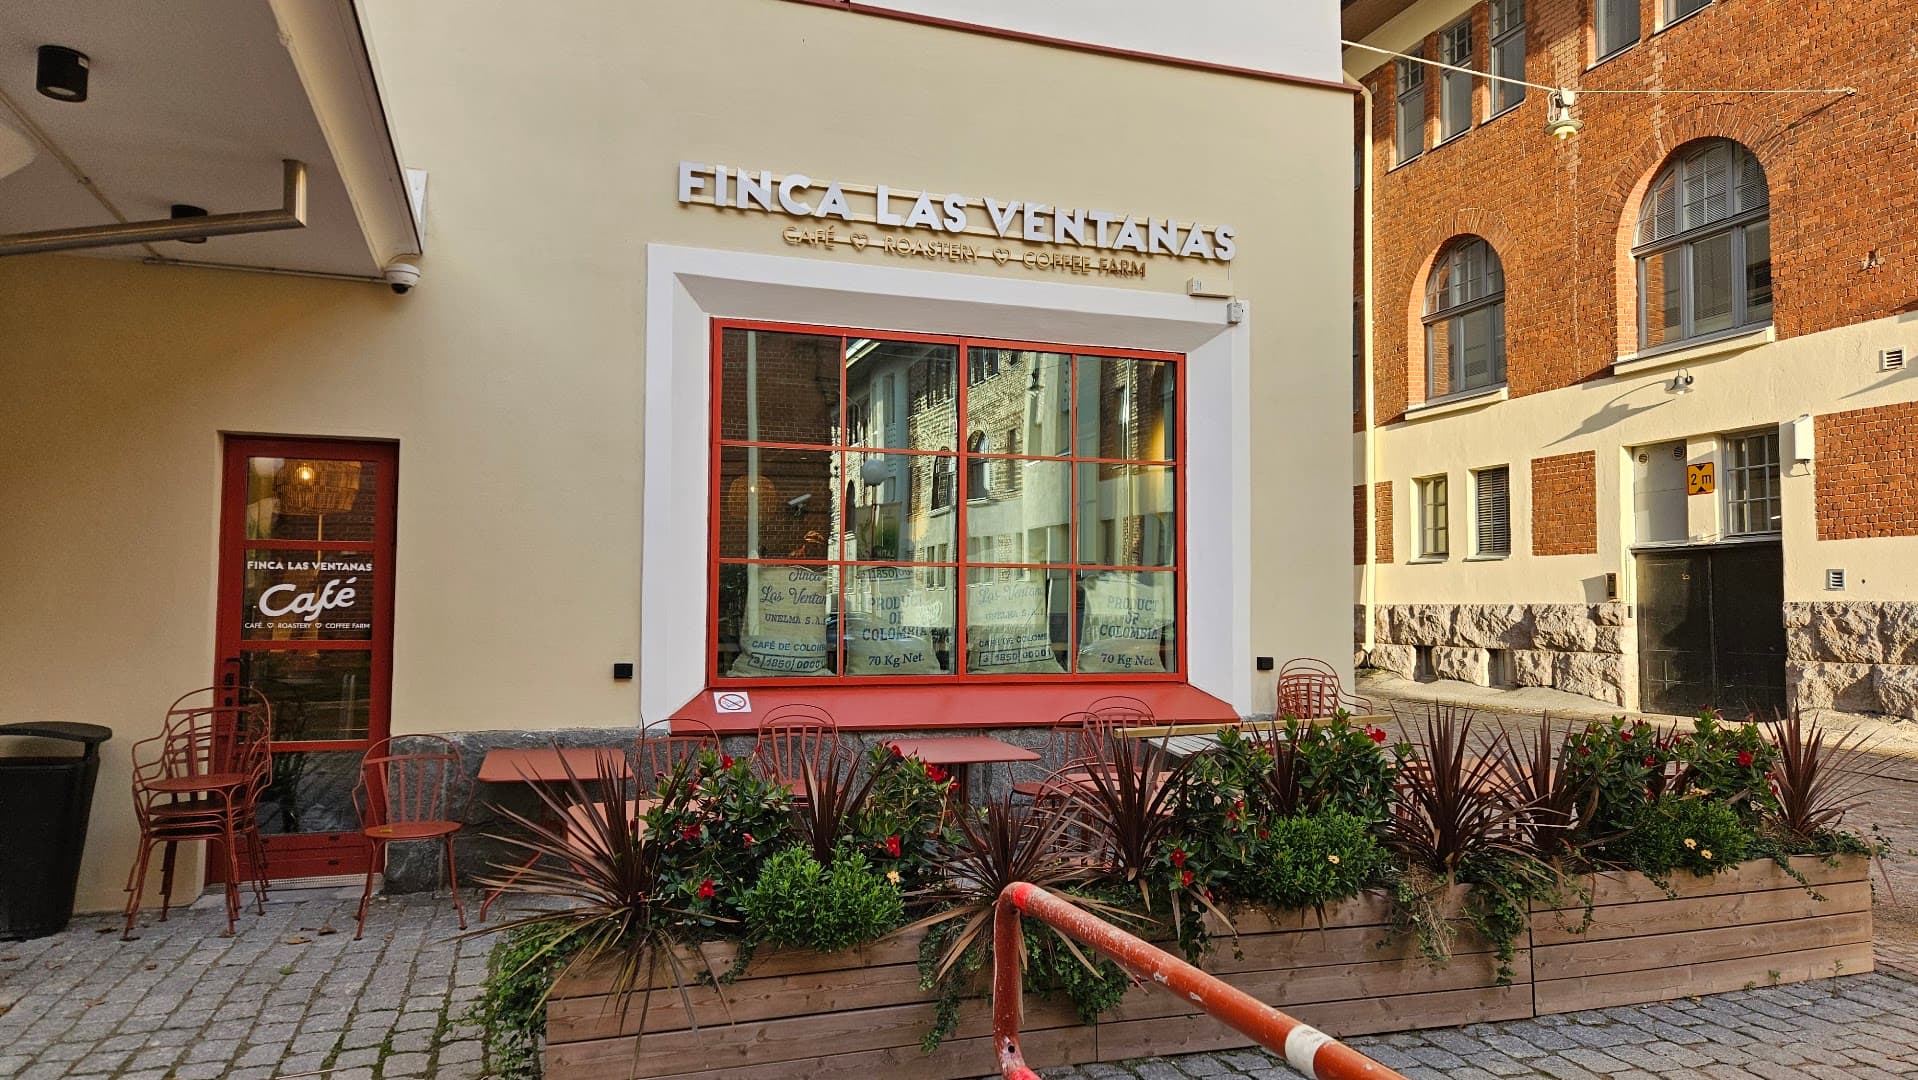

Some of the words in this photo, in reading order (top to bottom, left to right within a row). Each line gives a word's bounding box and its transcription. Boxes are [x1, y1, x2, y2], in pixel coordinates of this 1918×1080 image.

[678, 161, 853, 220] FINCA
[877, 184, 968, 233] LAS
[983, 197, 1238, 261] VENTANAS
[783, 225, 835, 248] CAFÉ
[884, 235, 979, 262] ROASTERY
[1022, 250, 1092, 275] COFFEE
[1099, 258, 1146, 279] FARM
[1690, 473, 1697, 486] 2
[1701, 474, 1712, 485] m
[247, 561, 284, 570] FINCA
[287, 562, 309, 570] LAS
[312, 562, 373, 571] VENTANAS
[258, 576, 357, 622] Café
[760, 584, 785, 605] Las
[752, 640, 776, 651] CAFÉ
[778, 642, 791, 651] DE
[868, 655, 881, 666] 70
[885, 655, 900, 669] Kg
[1101, 652, 1114, 664] 70
[1117, 653, 1132, 669] Kg
